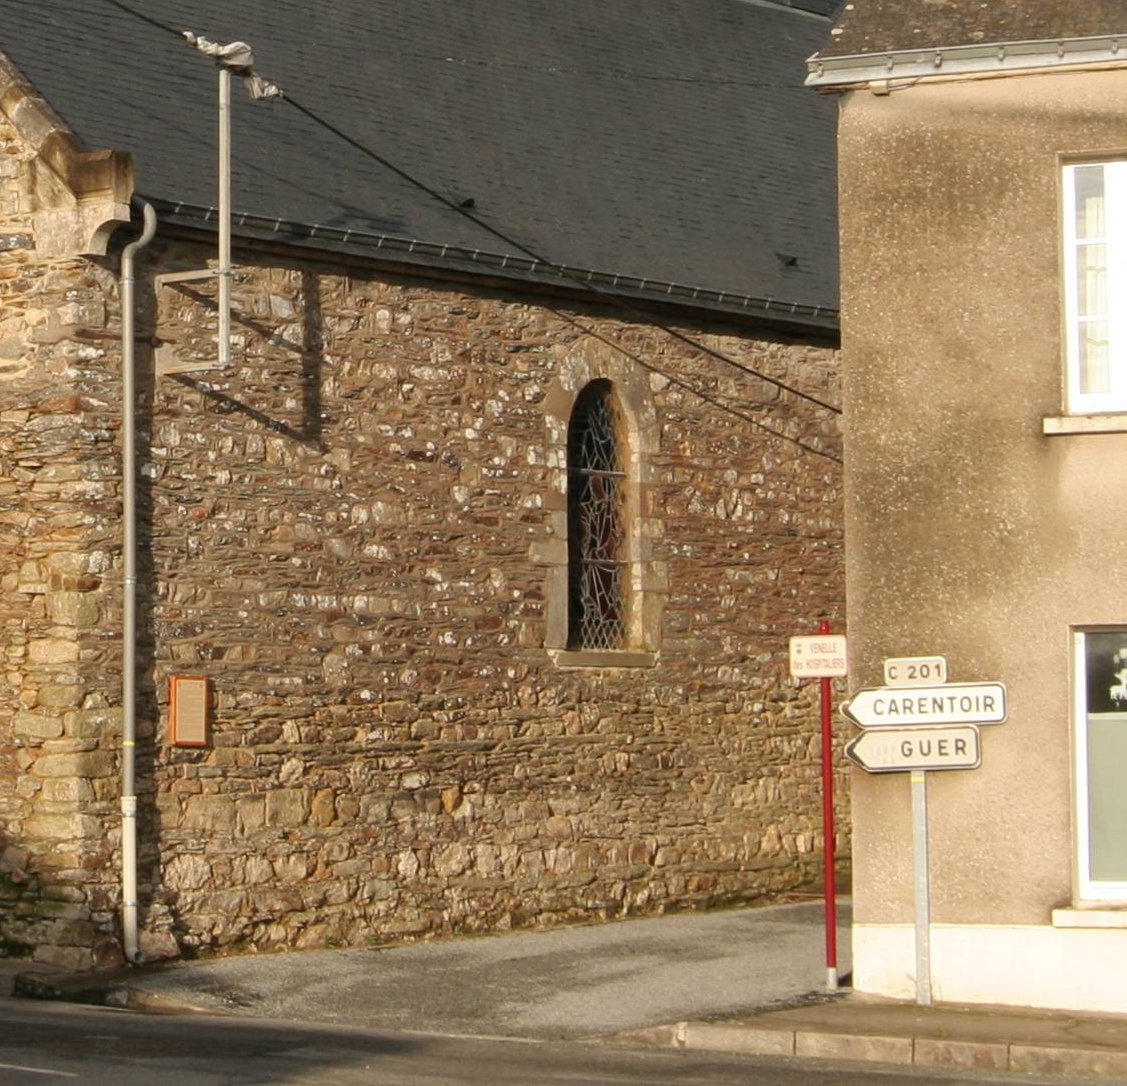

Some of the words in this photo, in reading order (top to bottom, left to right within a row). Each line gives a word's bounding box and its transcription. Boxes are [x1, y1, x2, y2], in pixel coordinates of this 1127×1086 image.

[809, 642, 837, 654] VENELLE
[888, 666, 898, 680] C
[907, 663, 942, 680] 201
[873, 695, 996, 716] CARENTOIR
[900, 737, 968, 758] GUER
